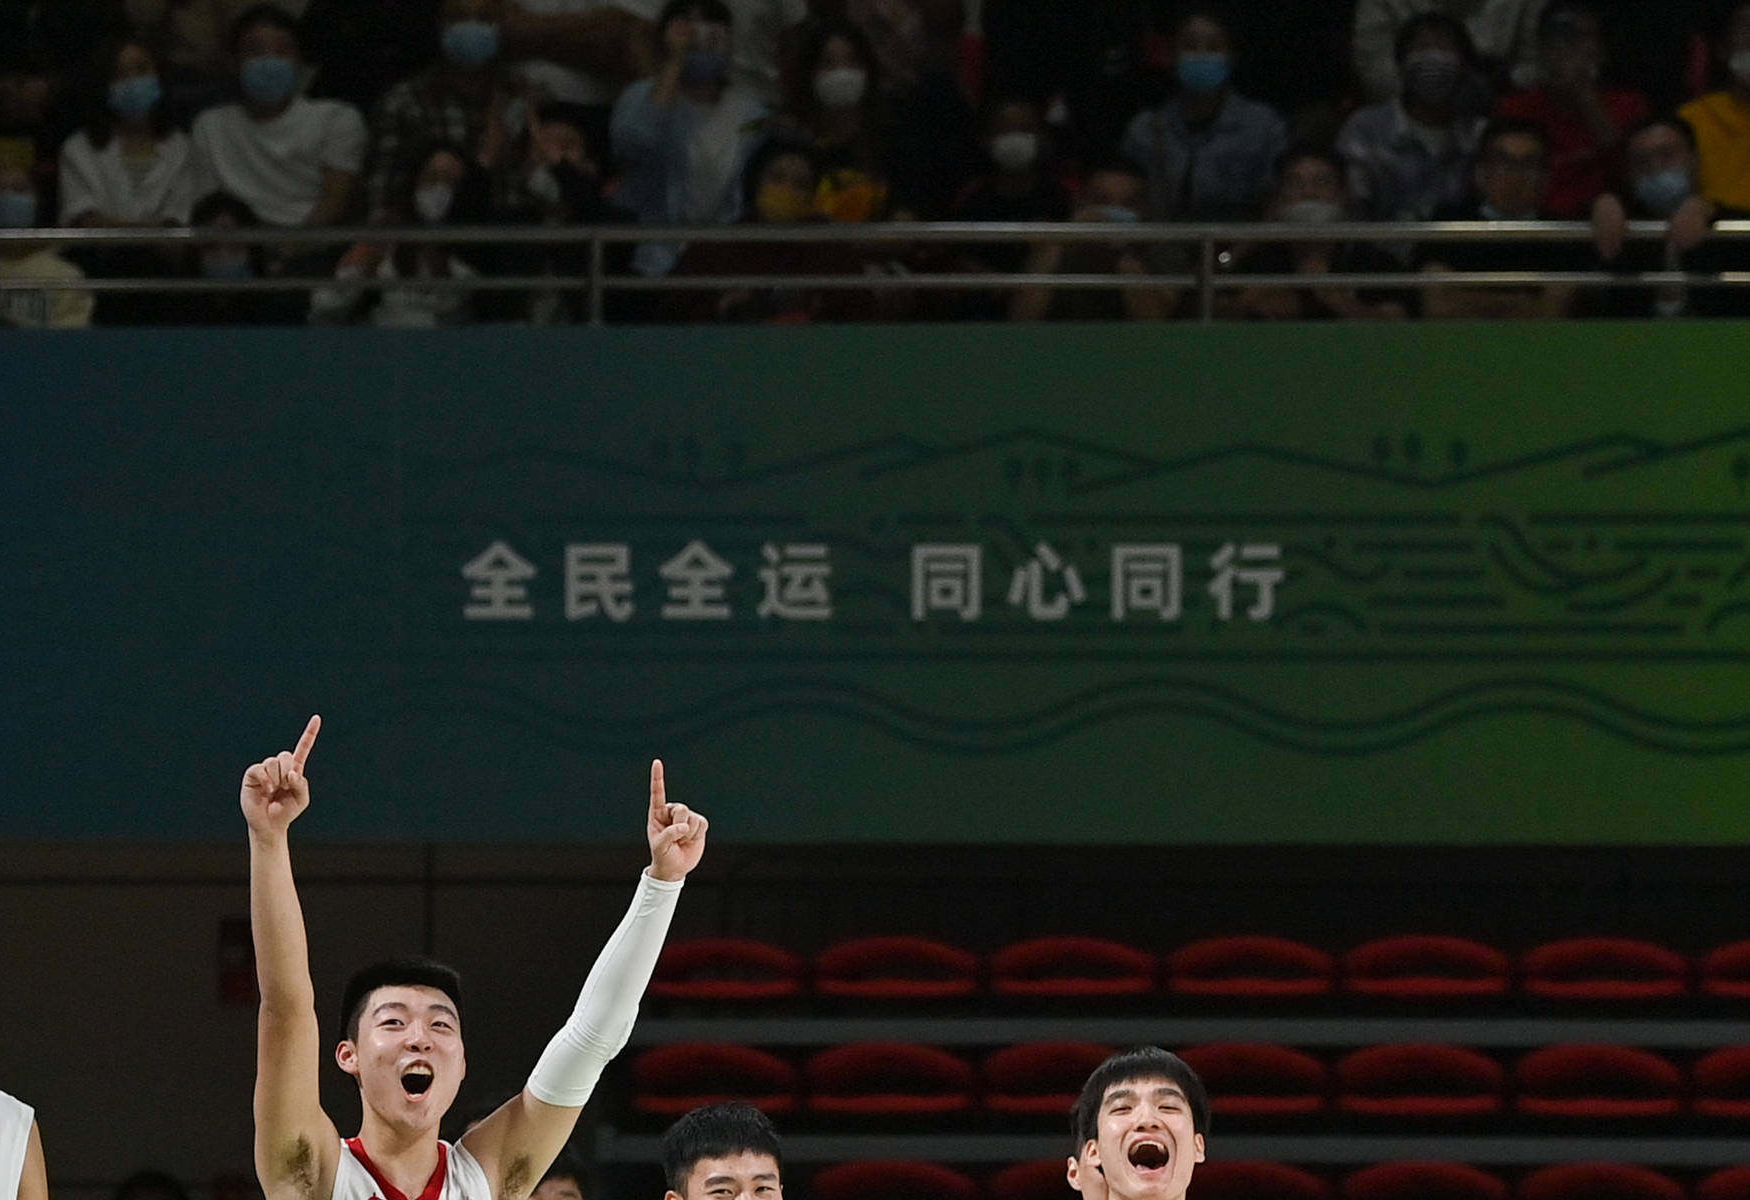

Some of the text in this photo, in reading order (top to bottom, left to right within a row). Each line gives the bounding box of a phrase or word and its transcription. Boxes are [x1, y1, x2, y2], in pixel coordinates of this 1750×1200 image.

[461, 541, 1284, 622] 全民全运 同心同行
